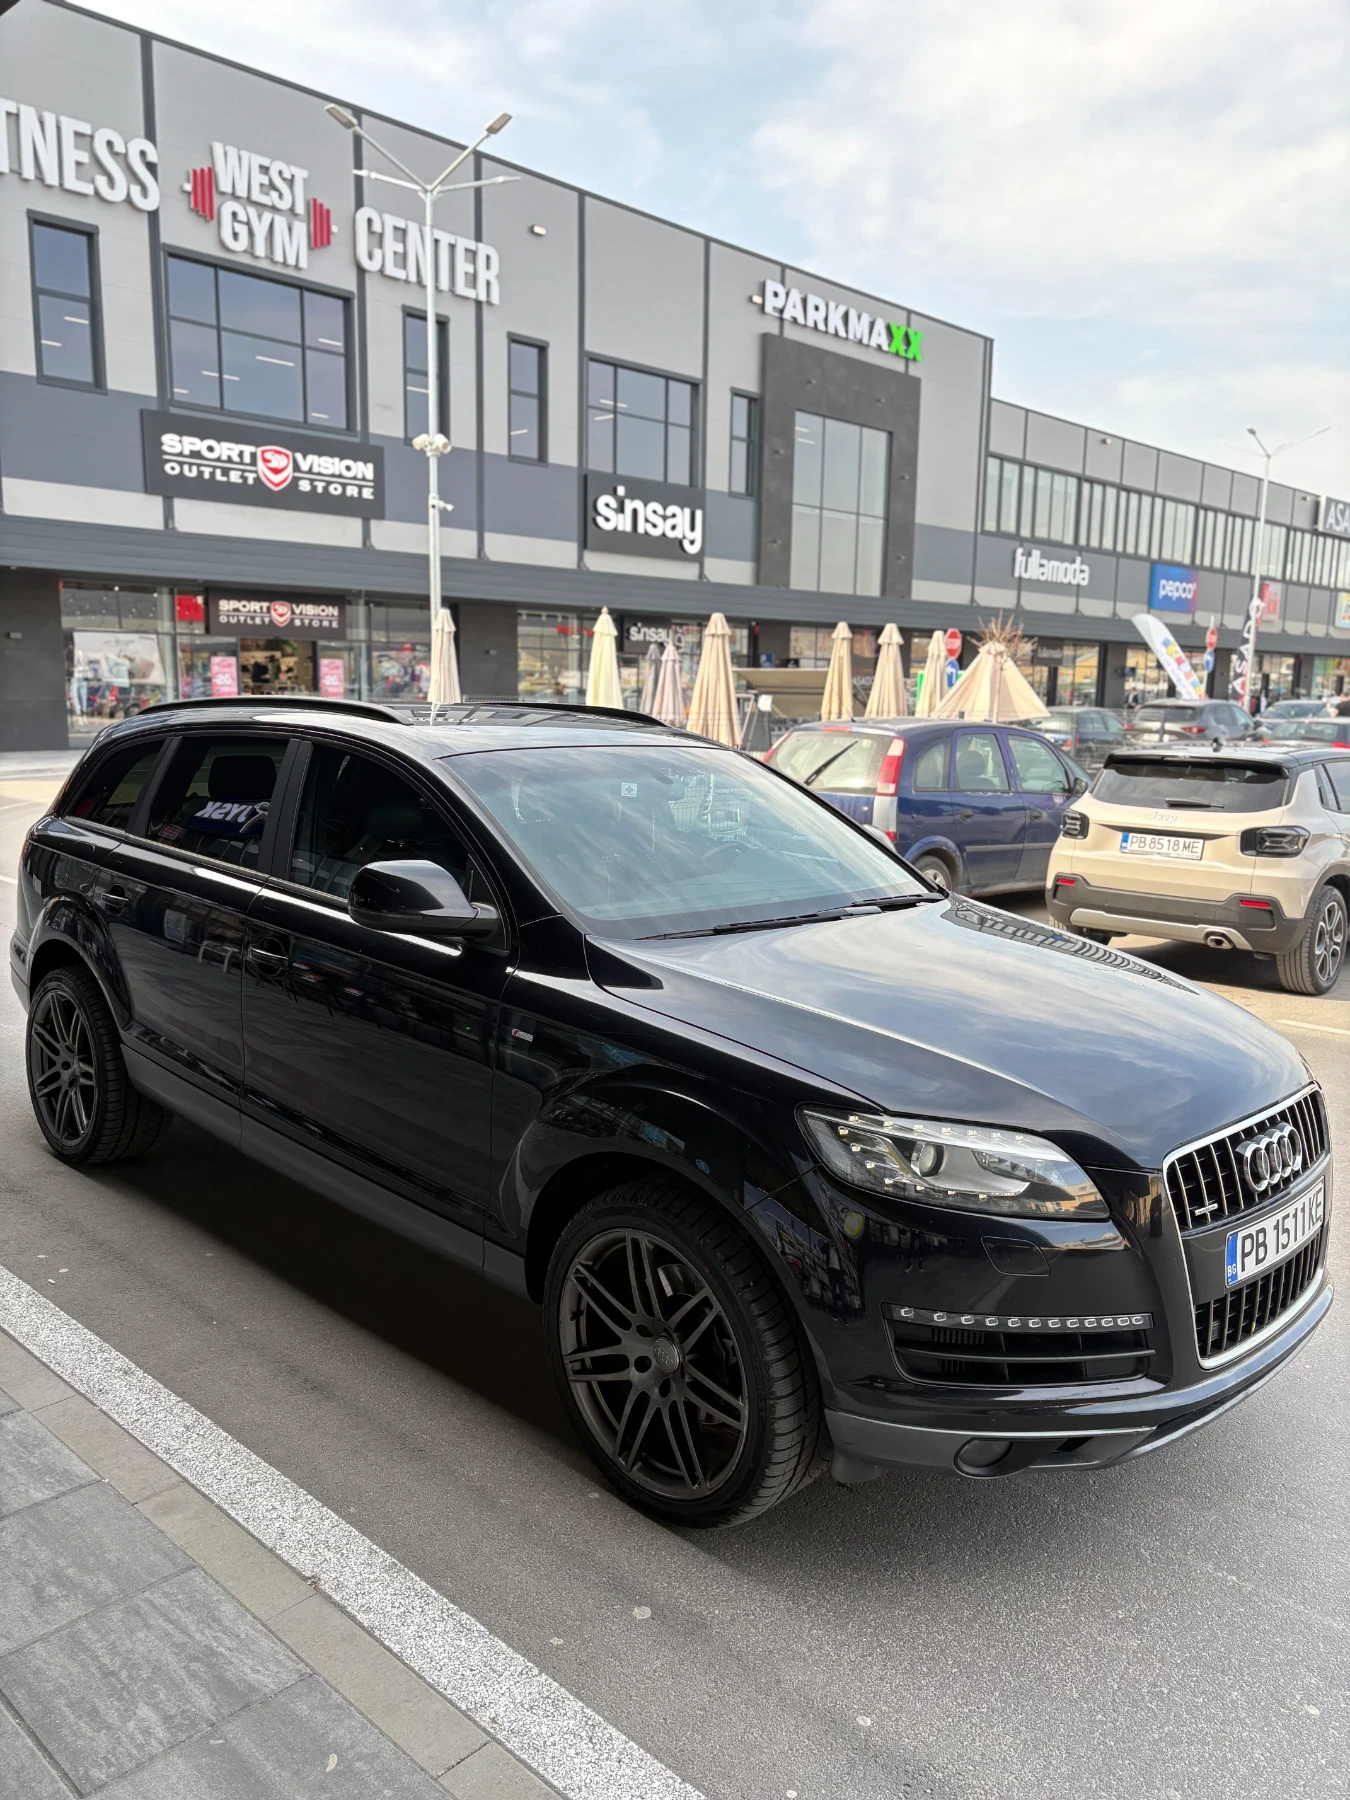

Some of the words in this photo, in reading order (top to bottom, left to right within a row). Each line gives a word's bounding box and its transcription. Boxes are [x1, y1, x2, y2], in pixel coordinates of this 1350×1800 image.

[211, 141, 309, 215] WEST
[219, 200, 309, 269] GYM
[355, 206, 500, 305] CENTER
[763, 278, 924, 362] PARKMAXX
[160, 433, 257, 464] SPORT
[294, 452, 374, 480] VISION
[164, 462, 257, 485] OUTLET
[298, 479, 375, 500] STORE
[595, 485, 703, 555] sinsay
[1013, 547, 1090, 587] fullamoda
[218, 600, 270, 613] SPORT
[292, 604, 339, 617] VISION
[218, 615, 270, 625] OUTLET
[294, 619, 339, 629] STORE
[1129, 835, 1147, 849] PB
[1149, 837, 1180, 852] 8518
[1182, 840, 1200, 854] ME
[1240, 1226, 1268, 1272] PB
[1273, 1201, 1306, 1255] 1511
[1308, 1186, 1322, 1231] KE
[1227, 1263, 1237, 1277] BG
